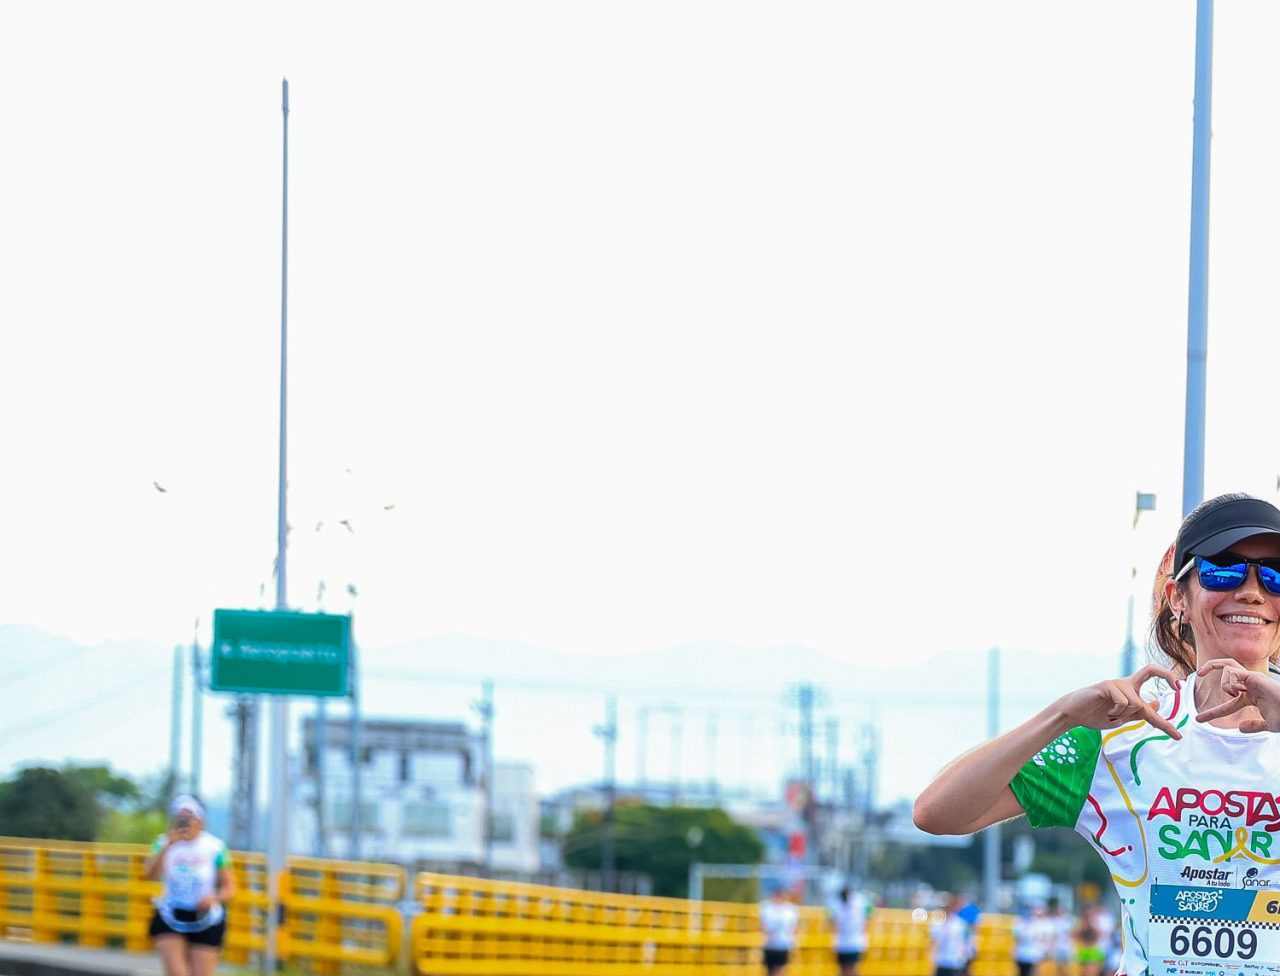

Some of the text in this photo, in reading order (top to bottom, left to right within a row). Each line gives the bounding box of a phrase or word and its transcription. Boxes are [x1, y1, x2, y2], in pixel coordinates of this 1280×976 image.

[1189, 814, 1232, 829] PARA
[1180, 866, 1231, 882] Apostar
[1175, 890, 1219, 902] APOSTAR
[1170, 925, 1258, 960] 6609
